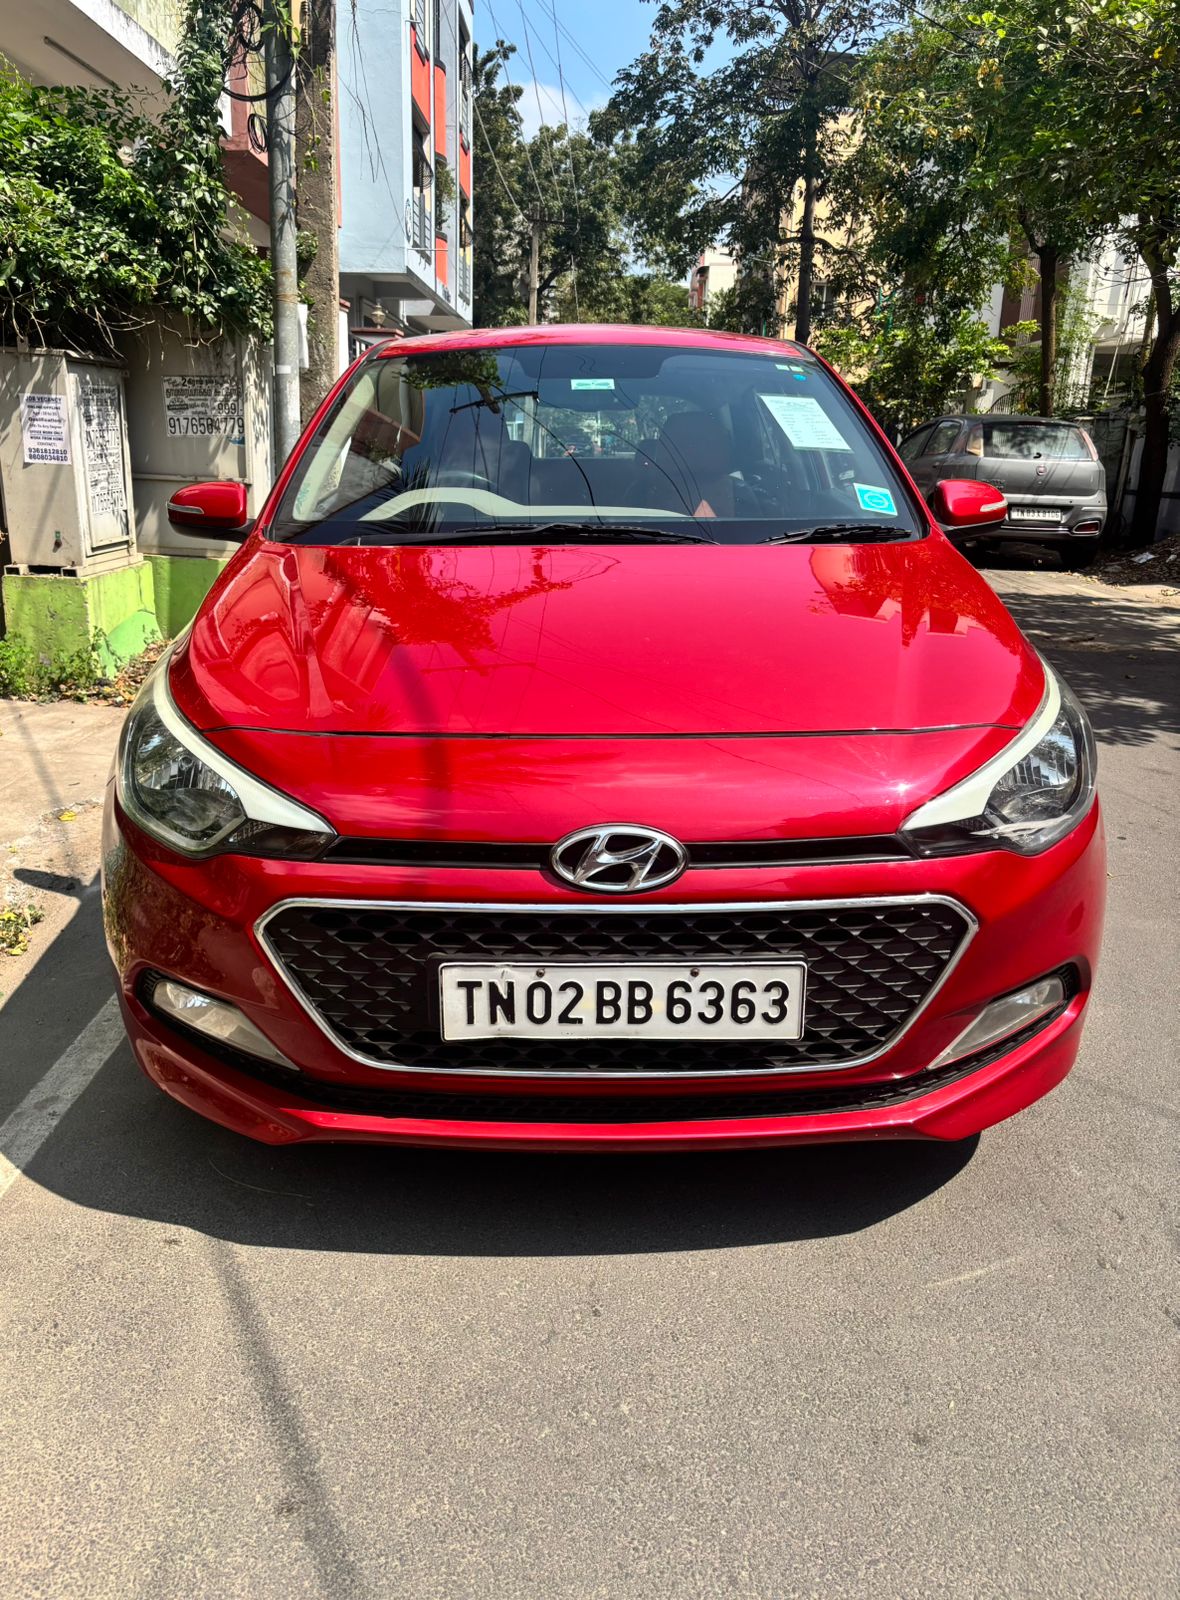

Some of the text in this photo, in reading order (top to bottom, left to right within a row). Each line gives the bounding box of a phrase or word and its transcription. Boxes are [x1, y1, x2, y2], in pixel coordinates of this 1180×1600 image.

[457, 980, 790, 1025] TN 02 BB 6363
